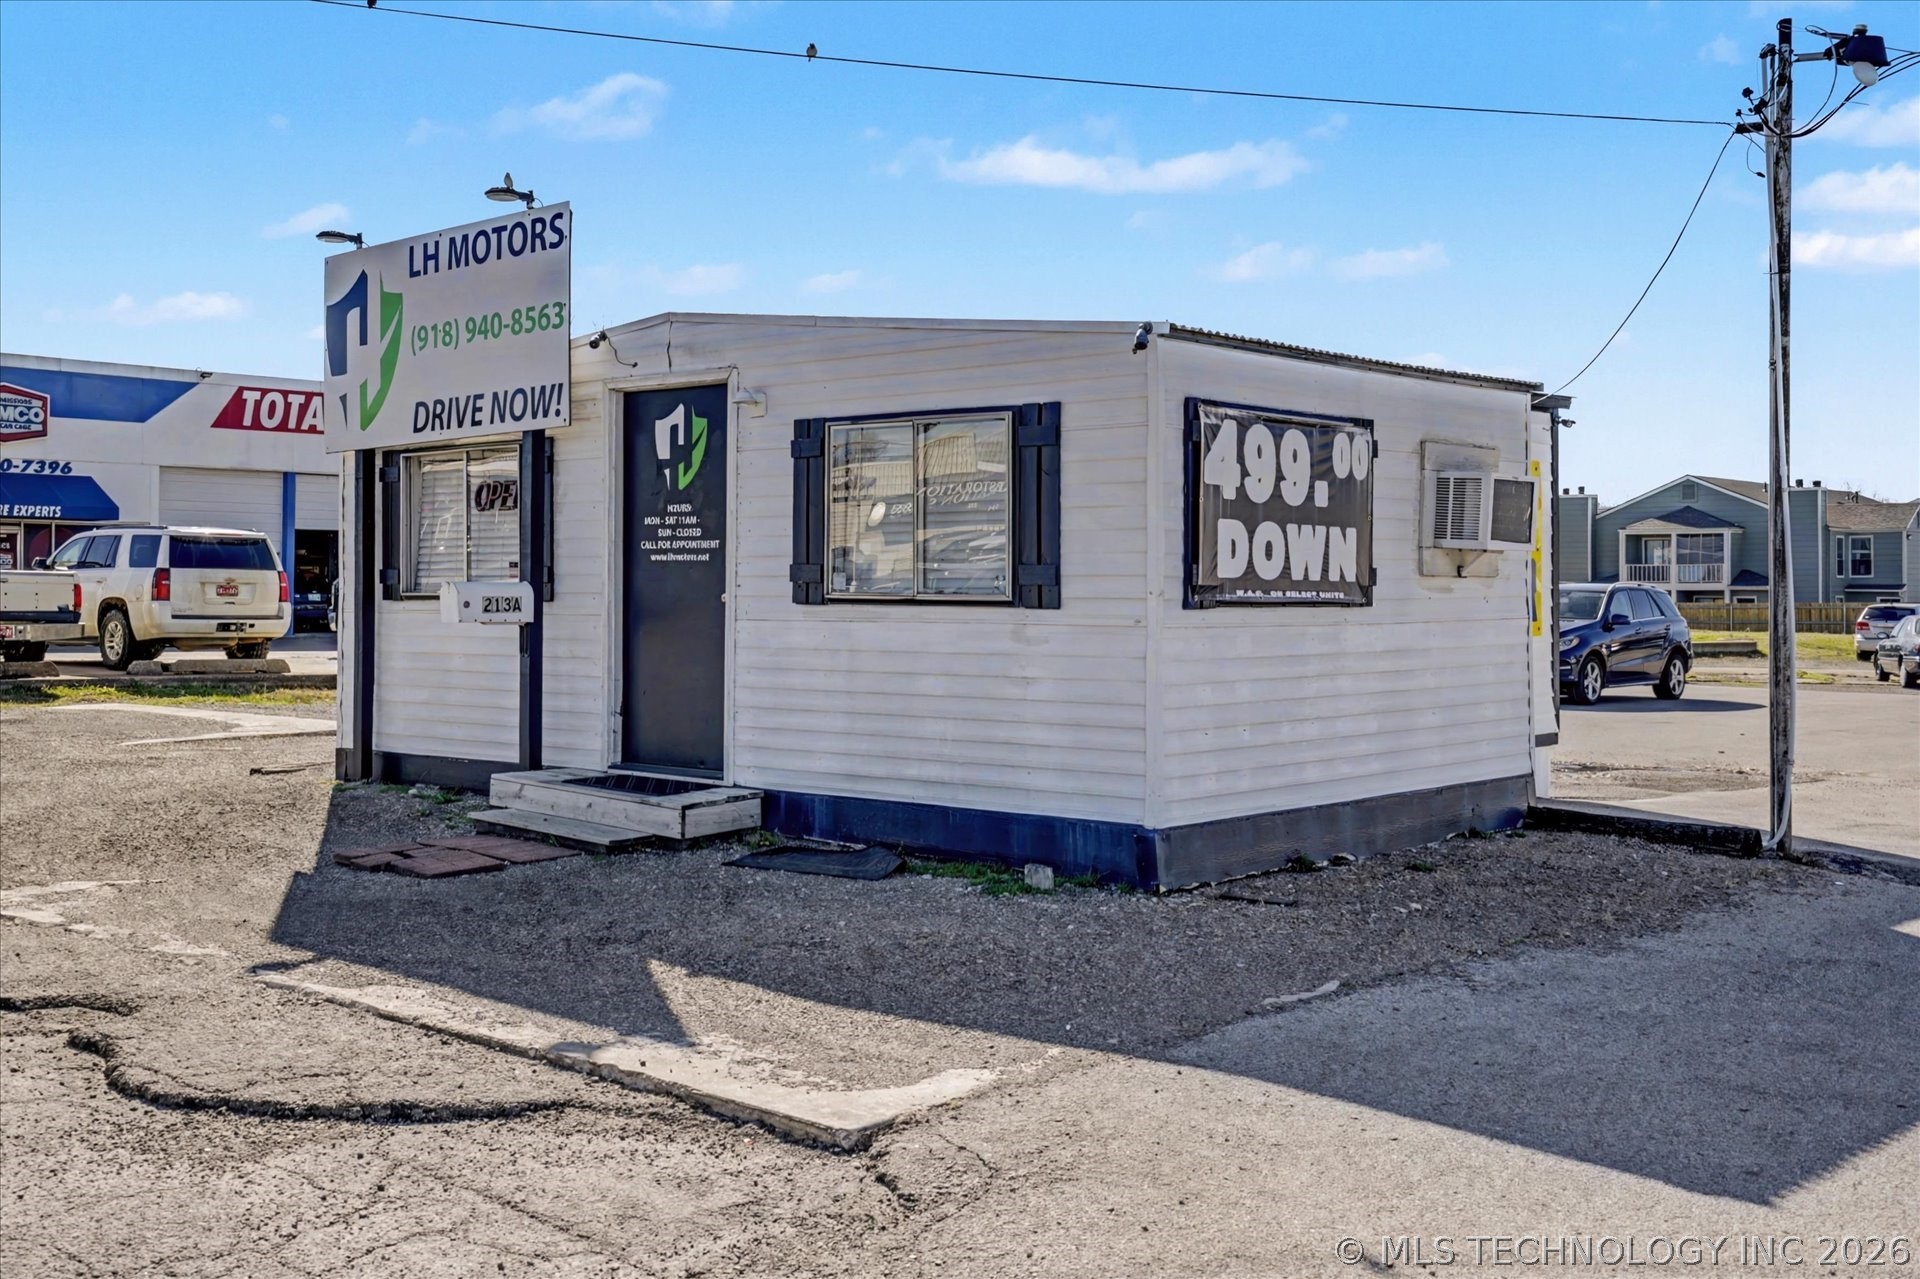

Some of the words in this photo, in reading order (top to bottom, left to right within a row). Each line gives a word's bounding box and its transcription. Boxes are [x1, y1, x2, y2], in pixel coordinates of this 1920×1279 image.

[409, 240, 440, 279] LH
[447, 212, 565, 271] MOTORS
[411, 318, 460, 356] (918)
[465, 301, 565, 343] 940-8563
[241, 390, 324, 431] TOTA
[412, 393, 485, 434] DRIVE
[490, 382, 564, 425] NOW!
[13, 504, 62, 518] EXPERTS
[644, 516, 660, 525] MON
[665, 516, 677, 524] SAT
[679, 516, 696, 524] 11AM
[658, 528, 672, 536] SUN
[676, 528, 701, 536] CLOSED
[640, 541, 657, 549] CALL
[658, 541, 671, 549] FOR
[672, 540, 720, 549] APPOINTMENT
[1217, 518, 1358, 582] DOWN
[1285, 590, 1317, 598] SELECT
[1319, 591, 1345, 599] UNITS
[483, 597, 522, 613] 213A
